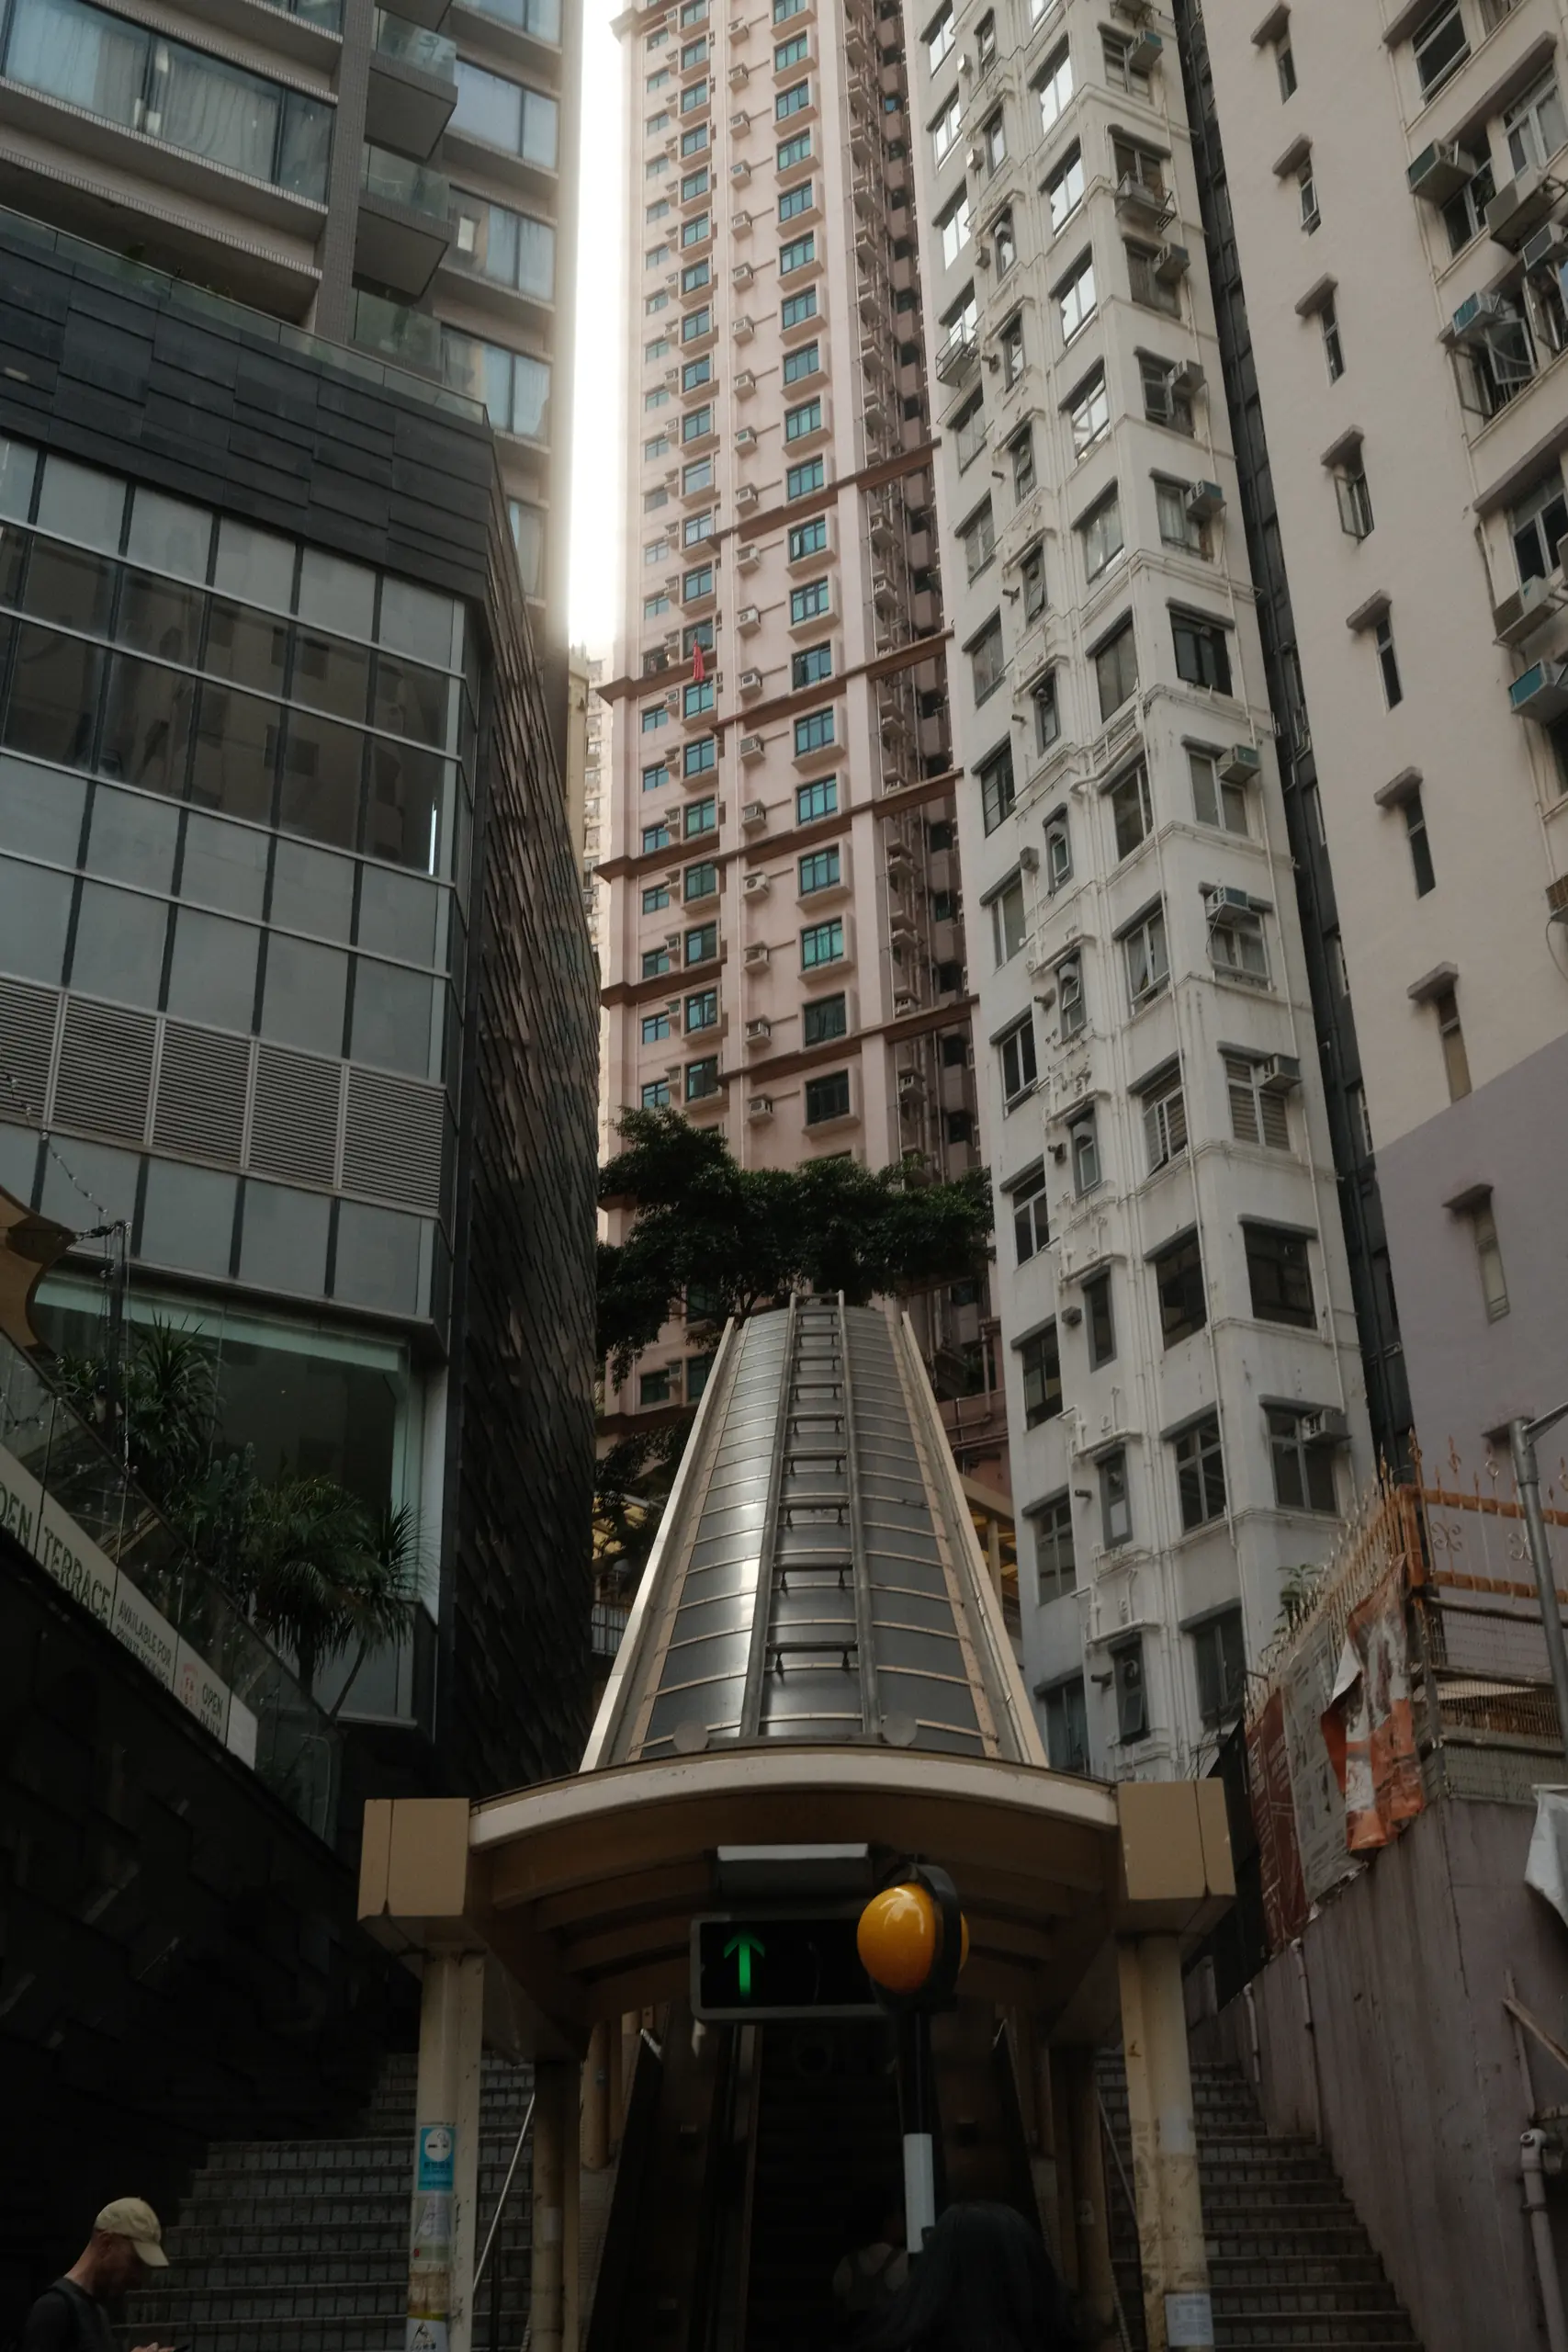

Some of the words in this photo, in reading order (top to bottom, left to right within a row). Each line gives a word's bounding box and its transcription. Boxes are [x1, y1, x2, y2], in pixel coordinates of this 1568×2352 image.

[44, 1526, 110, 1628] TERRACE
[117, 1600, 157, 1654] AVAILABLE
[156, 1639, 172, 1668] FOR
[202, 1683, 223, 1720] OPEN
